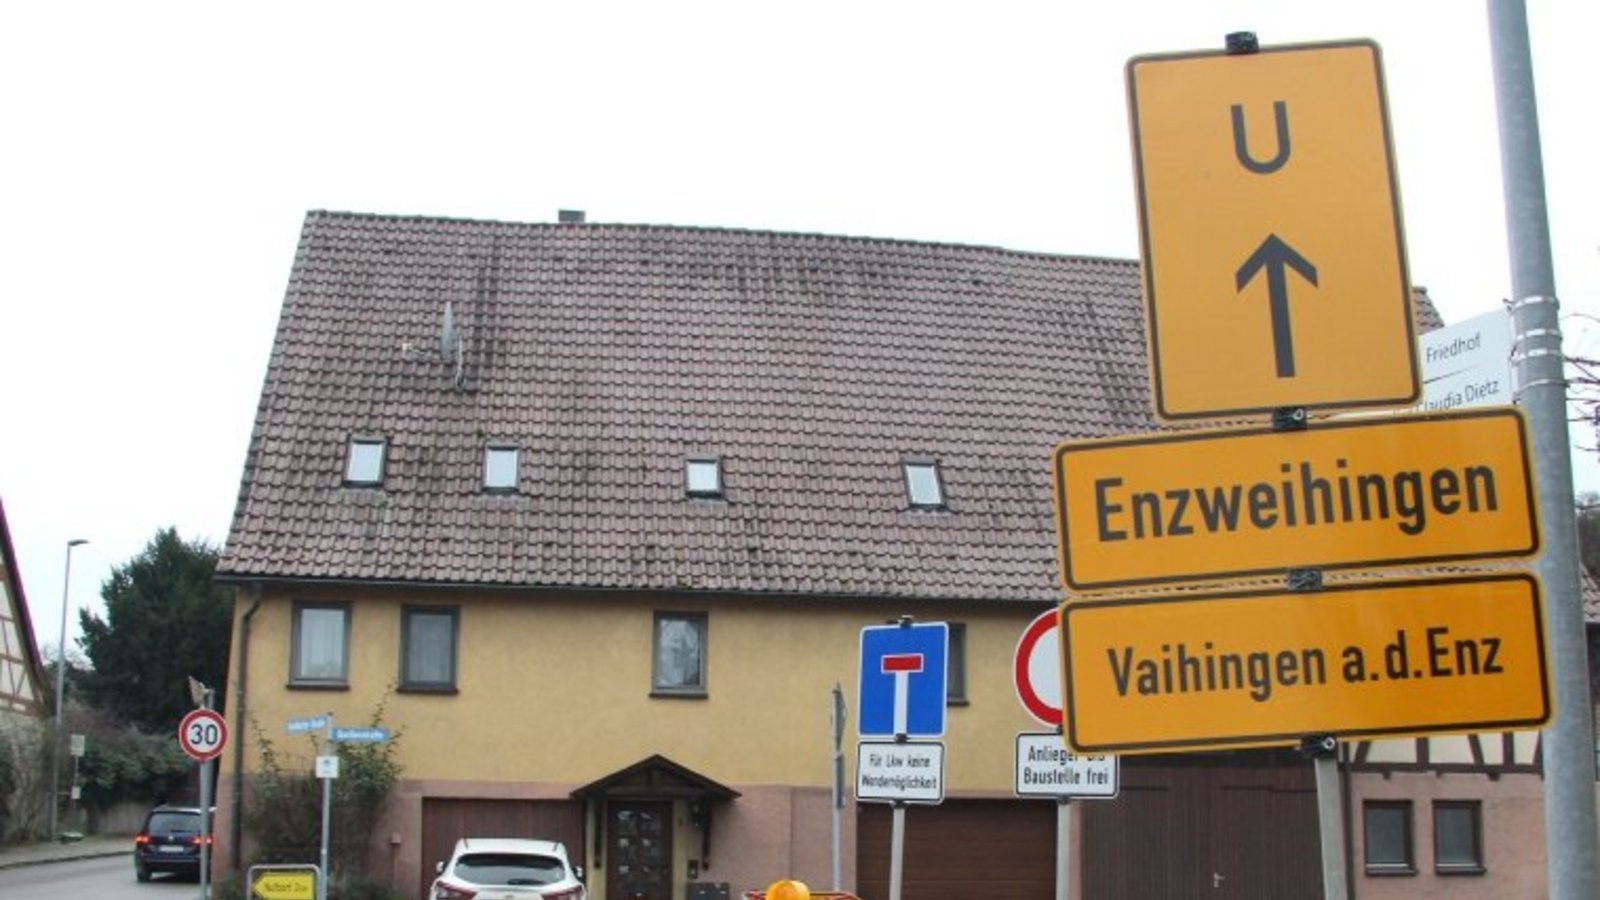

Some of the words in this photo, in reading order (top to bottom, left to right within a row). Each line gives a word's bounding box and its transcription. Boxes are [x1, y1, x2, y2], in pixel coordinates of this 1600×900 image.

[1230, 101, 1292, 175] U
[1425, 332, 1481, 363] Friedhof
[1464, 380, 1500, 402] Dietz
[1095, 459, 1499, 543] Enzweihingen
[1107, 642, 1327, 704] Vaihingen
[190, 723, 219, 746] 30
[869, 753, 882, 768] Für
[907, 753, 930, 768] keine
[1028, 745, 1078, 766] Anlieger
[1023, 766, 1080, 785] Baustelle
[1086, 767, 1109, 785] frei
